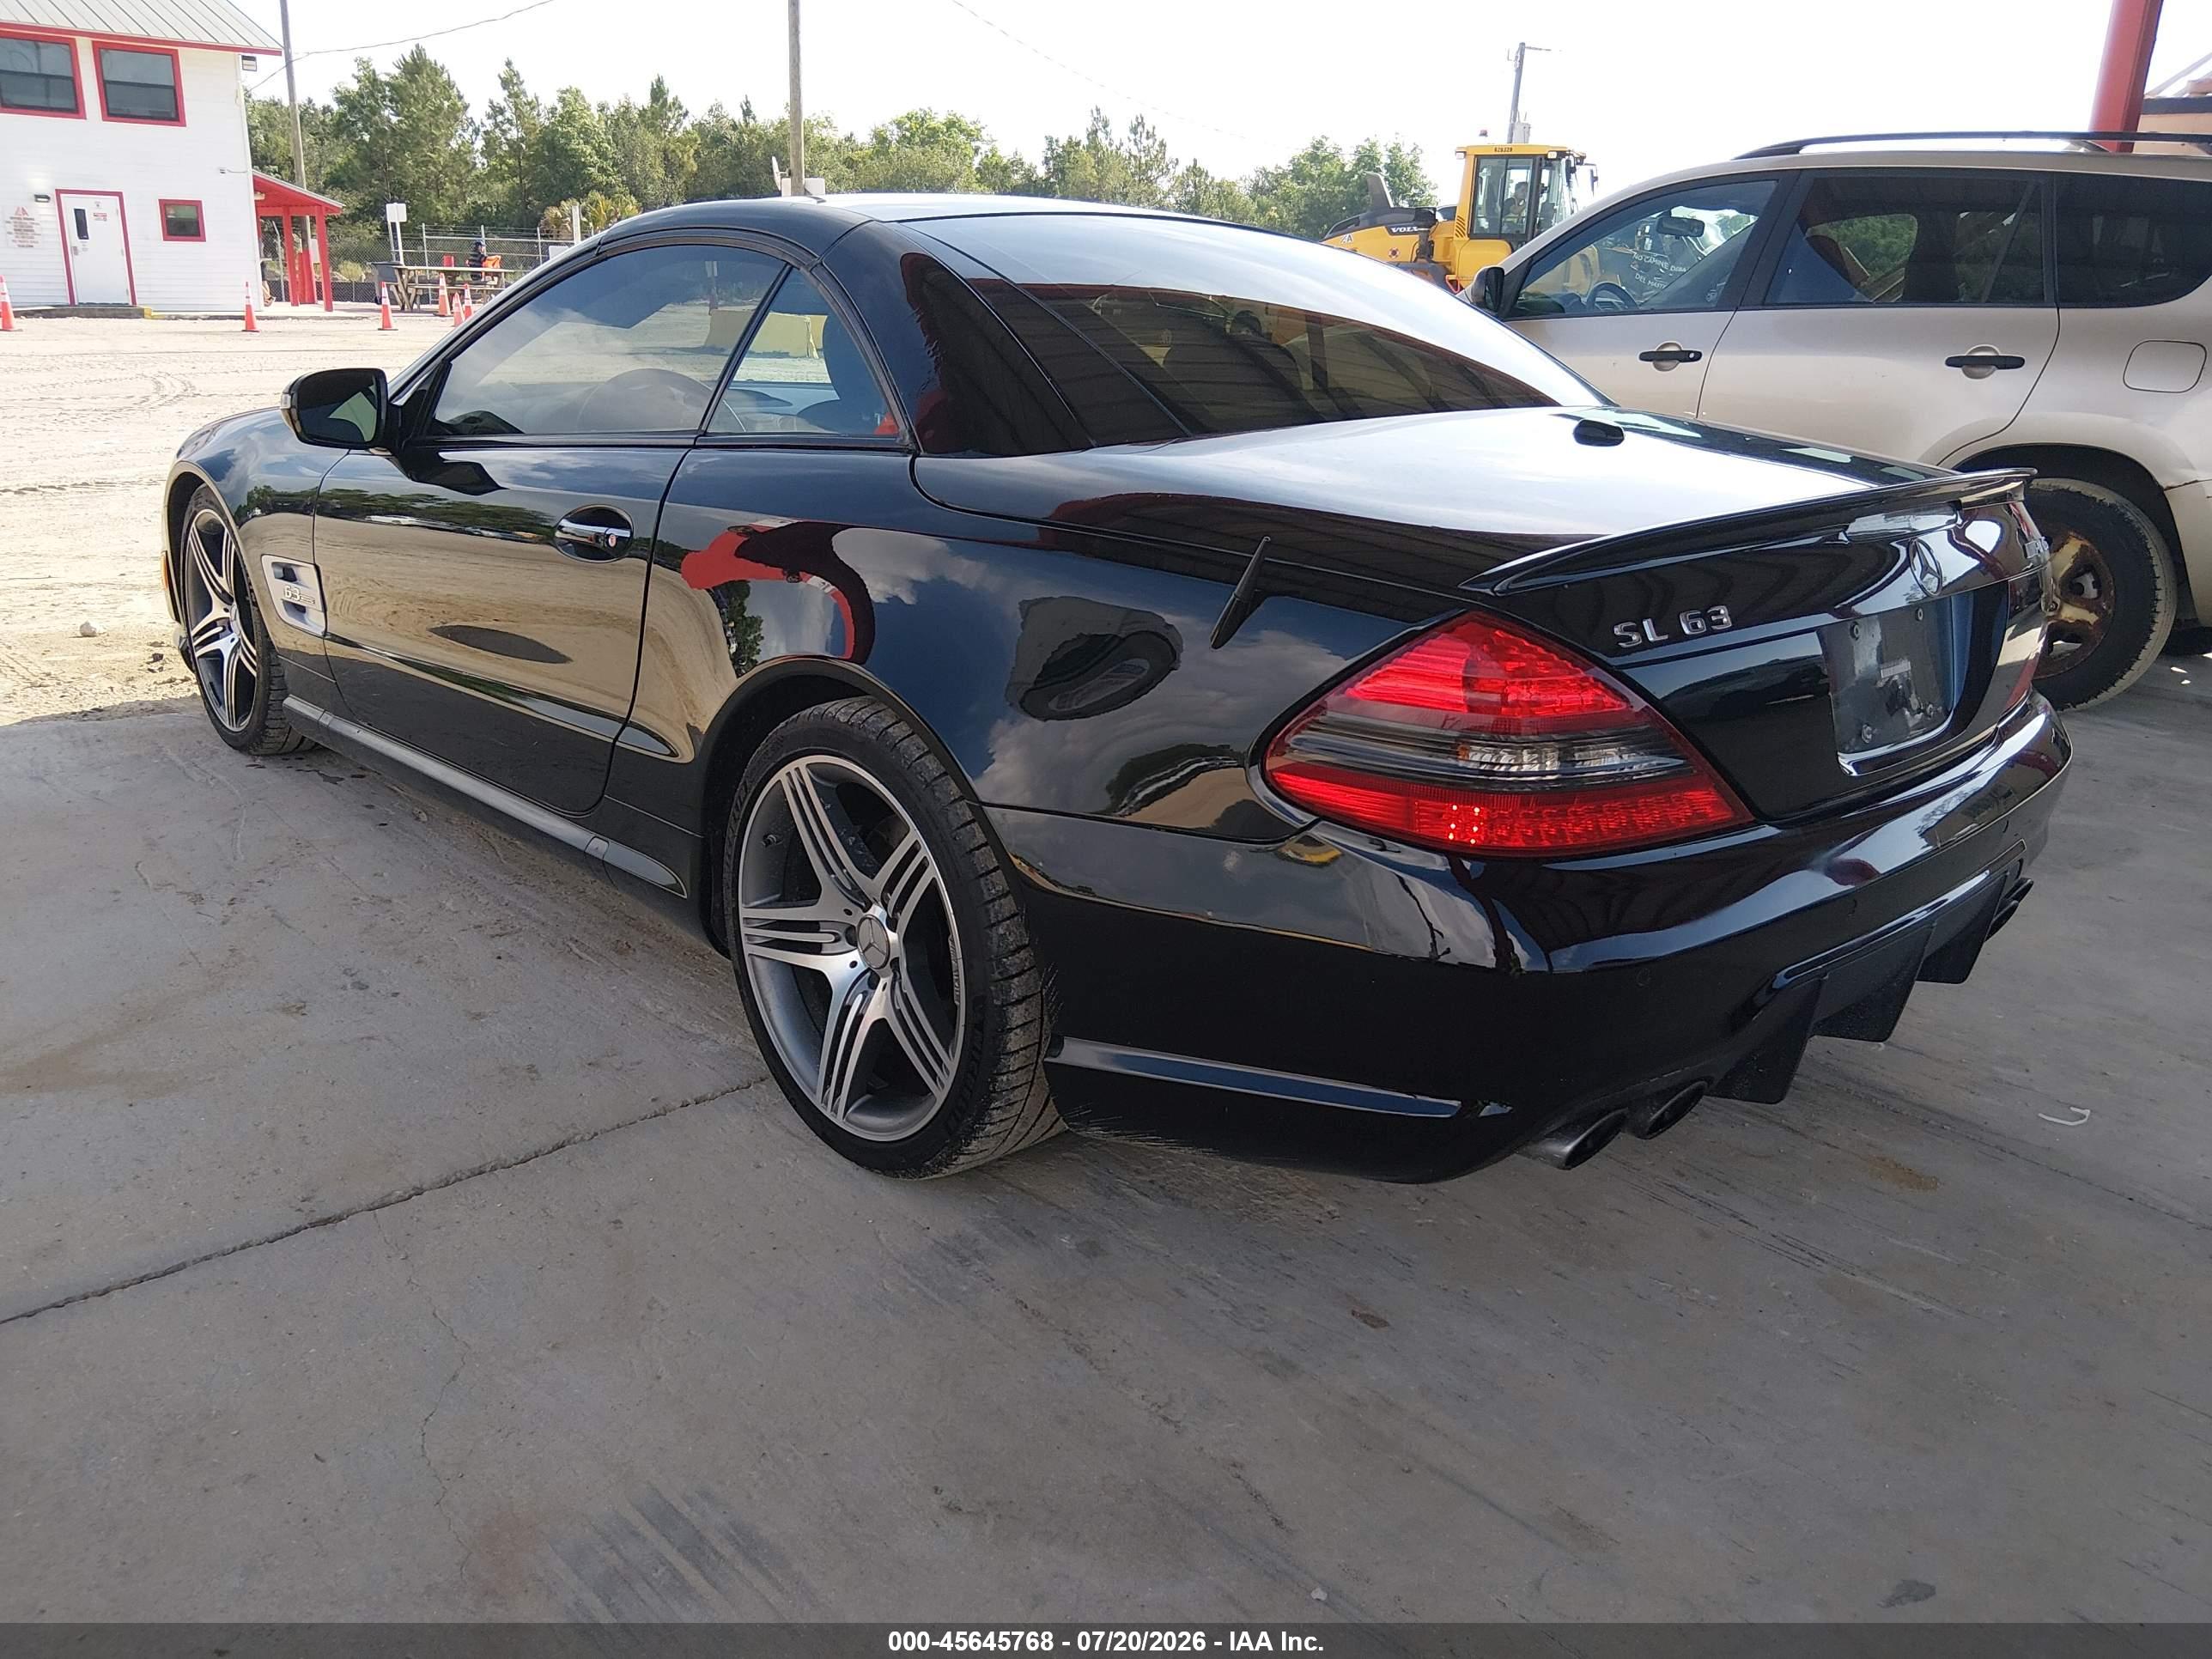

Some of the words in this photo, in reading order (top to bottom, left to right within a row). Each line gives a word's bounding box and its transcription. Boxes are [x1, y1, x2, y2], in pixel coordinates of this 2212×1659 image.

[1644, 255, 1669, 270] CAMINE
[1635, 273, 1646, 283] DEL
[284, 585, 301, 601] 63
[1613, 618, 1669, 648] SL
[1679, 605, 1733, 635] 63
